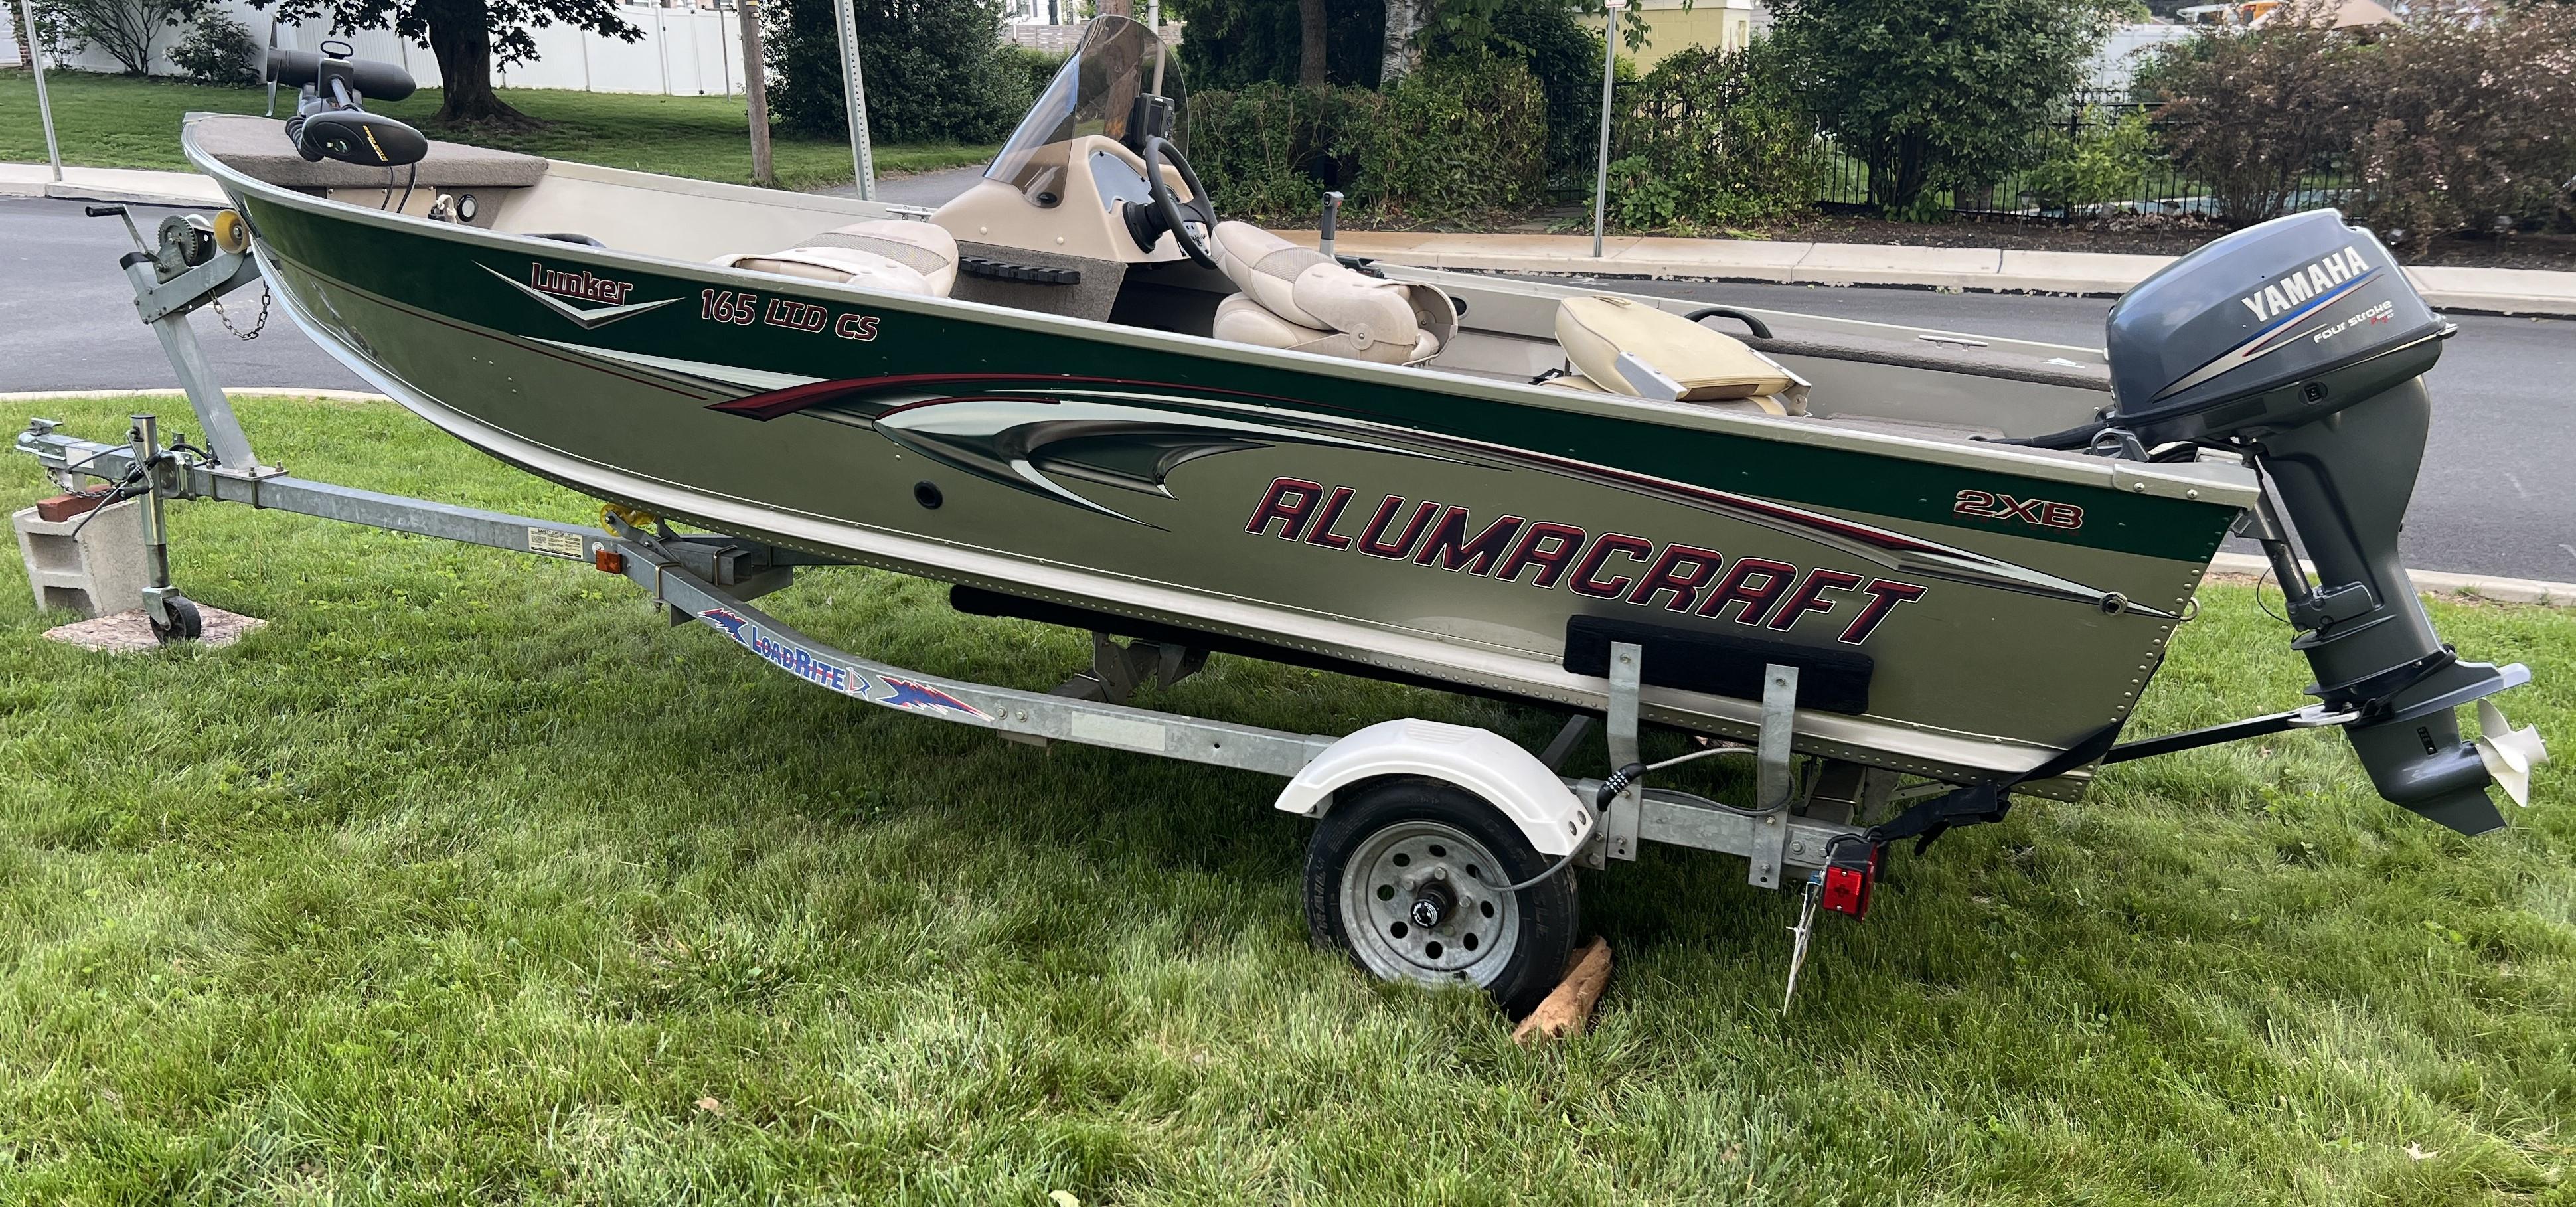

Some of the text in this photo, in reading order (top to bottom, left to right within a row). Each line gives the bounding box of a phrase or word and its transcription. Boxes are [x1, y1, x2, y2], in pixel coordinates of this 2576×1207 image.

[531, 262, 633, 307] Lunker
[2241, 246, 2369, 323] YAMAHA
[700, 288, 880, 342] 165 LTD CS
[1953, 489, 2084, 530] 2XB
[1244, 475, 1929, 645] ALUMACRAFT
